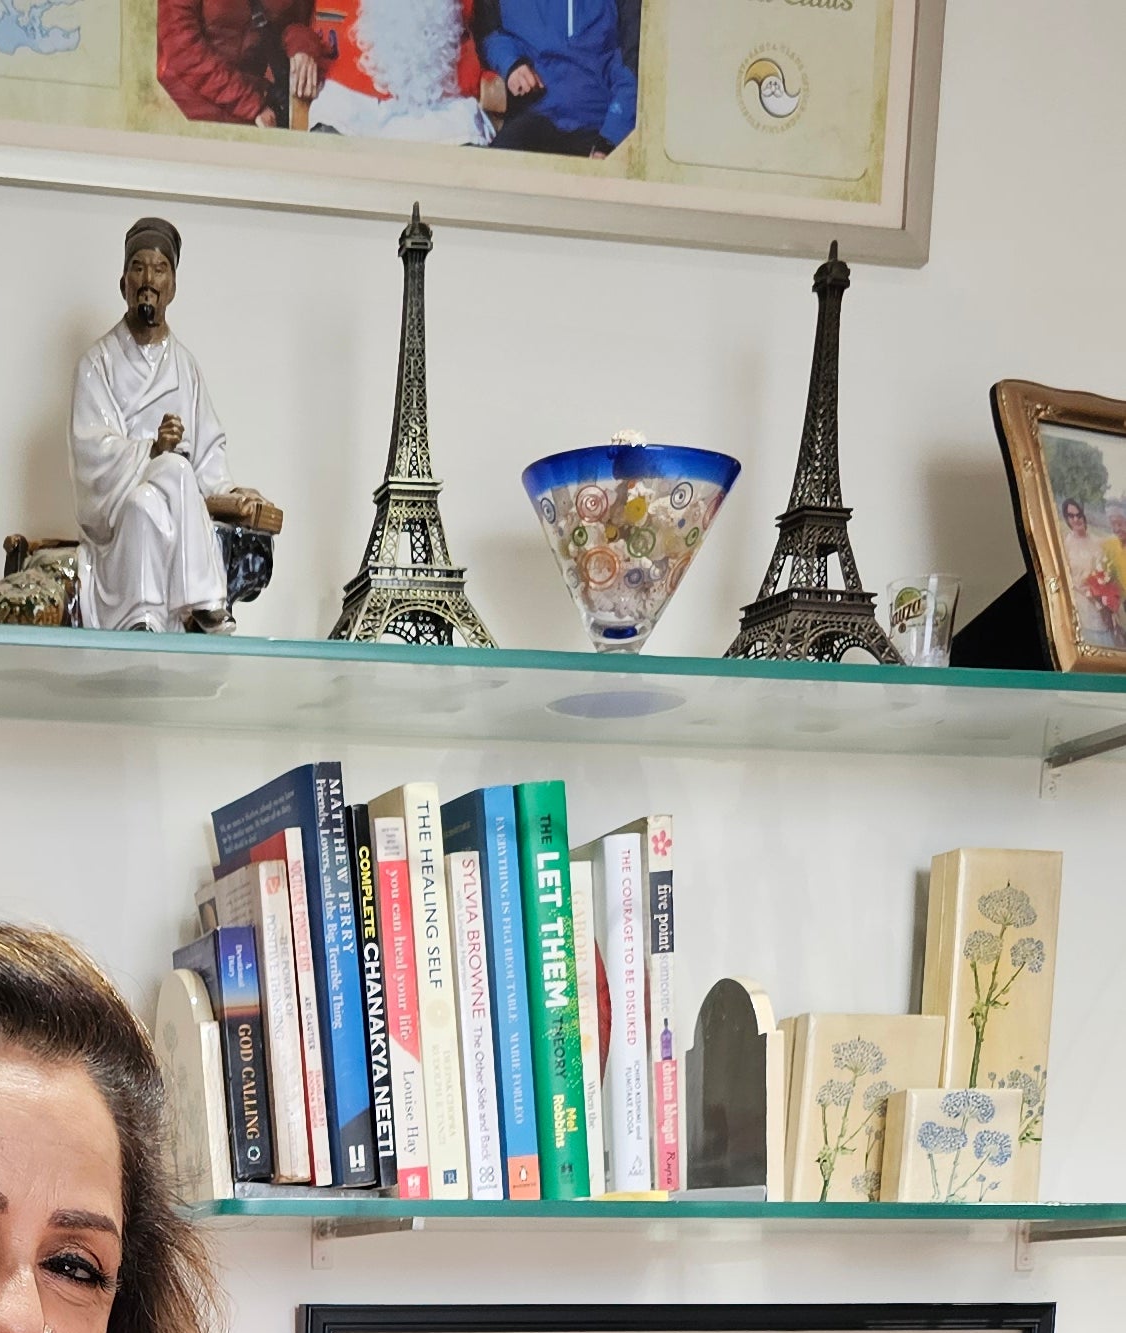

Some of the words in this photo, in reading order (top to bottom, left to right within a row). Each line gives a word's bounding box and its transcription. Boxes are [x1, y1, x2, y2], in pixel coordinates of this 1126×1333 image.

[316, 779, 327, 827] Friends,
[417, 801, 431, 842] THE
[329, 778, 349, 885] MATTHEW
[540, 814, 552, 844] THE
[319, 829, 330, 874] Lovers,
[495, 816, 509, 898] EVERYTHING
[621, 849, 631, 873] THE
[324, 875, 336, 898] and
[358, 846, 375, 939] COMPLETE
[386, 867, 399, 898] you
[420, 849, 438, 939] HEALING
[462, 859, 479, 924] SYLVIA
[536, 852, 562, 908] LET
[657, 884, 671, 910] five
[325, 900, 337, 920] the
[338, 892, 354, 954] PERRY
[391, 904, 402, 931] can
[501, 901, 510, 915] IS
[622, 878, 633, 942] COURAGE
[325, 923, 338, 943] Big
[654, 914, 673, 952] point
[328, 945, 341, 991] Terrible
[393, 936, 407, 970] heal
[428, 946, 442, 989] SELF
[541, 917, 568, 1009] THEM
[625, 949, 634, 964] TO
[392, 974, 407, 1010] your
[467, 930, 486, 1019] BROWNE
[625, 971, 634, 984] BE
[659, 954, 670, 1013] someone
[332, 993, 344, 1029] Thing
[399, 1013, 413, 1041] life
[625, 990, 636, 1045] DISLIKED
[238, 1023, 253, 1061] GOD
[473, 1027, 482, 1048] The
[510, 1032, 521, 1072] MARIE
[552, 1017, 567, 1080] THEORY
[475, 1051, 485, 1085] Other
[663, 1061, 676, 1098] chetan
[241, 1066, 260, 1140] CALLING
[403, 1070, 415, 1121] Louise
[477, 1086, 487, 1111] Side
[479, 1112, 489, 1132] and
[553, 1094, 565, 1148] Robbins
[566, 1108, 578, 1132] Mel
[662, 1102, 677, 1145] bhagat
[404, 1125, 418, 1155] Hay
[480, 1135, 490, 1161] Back
